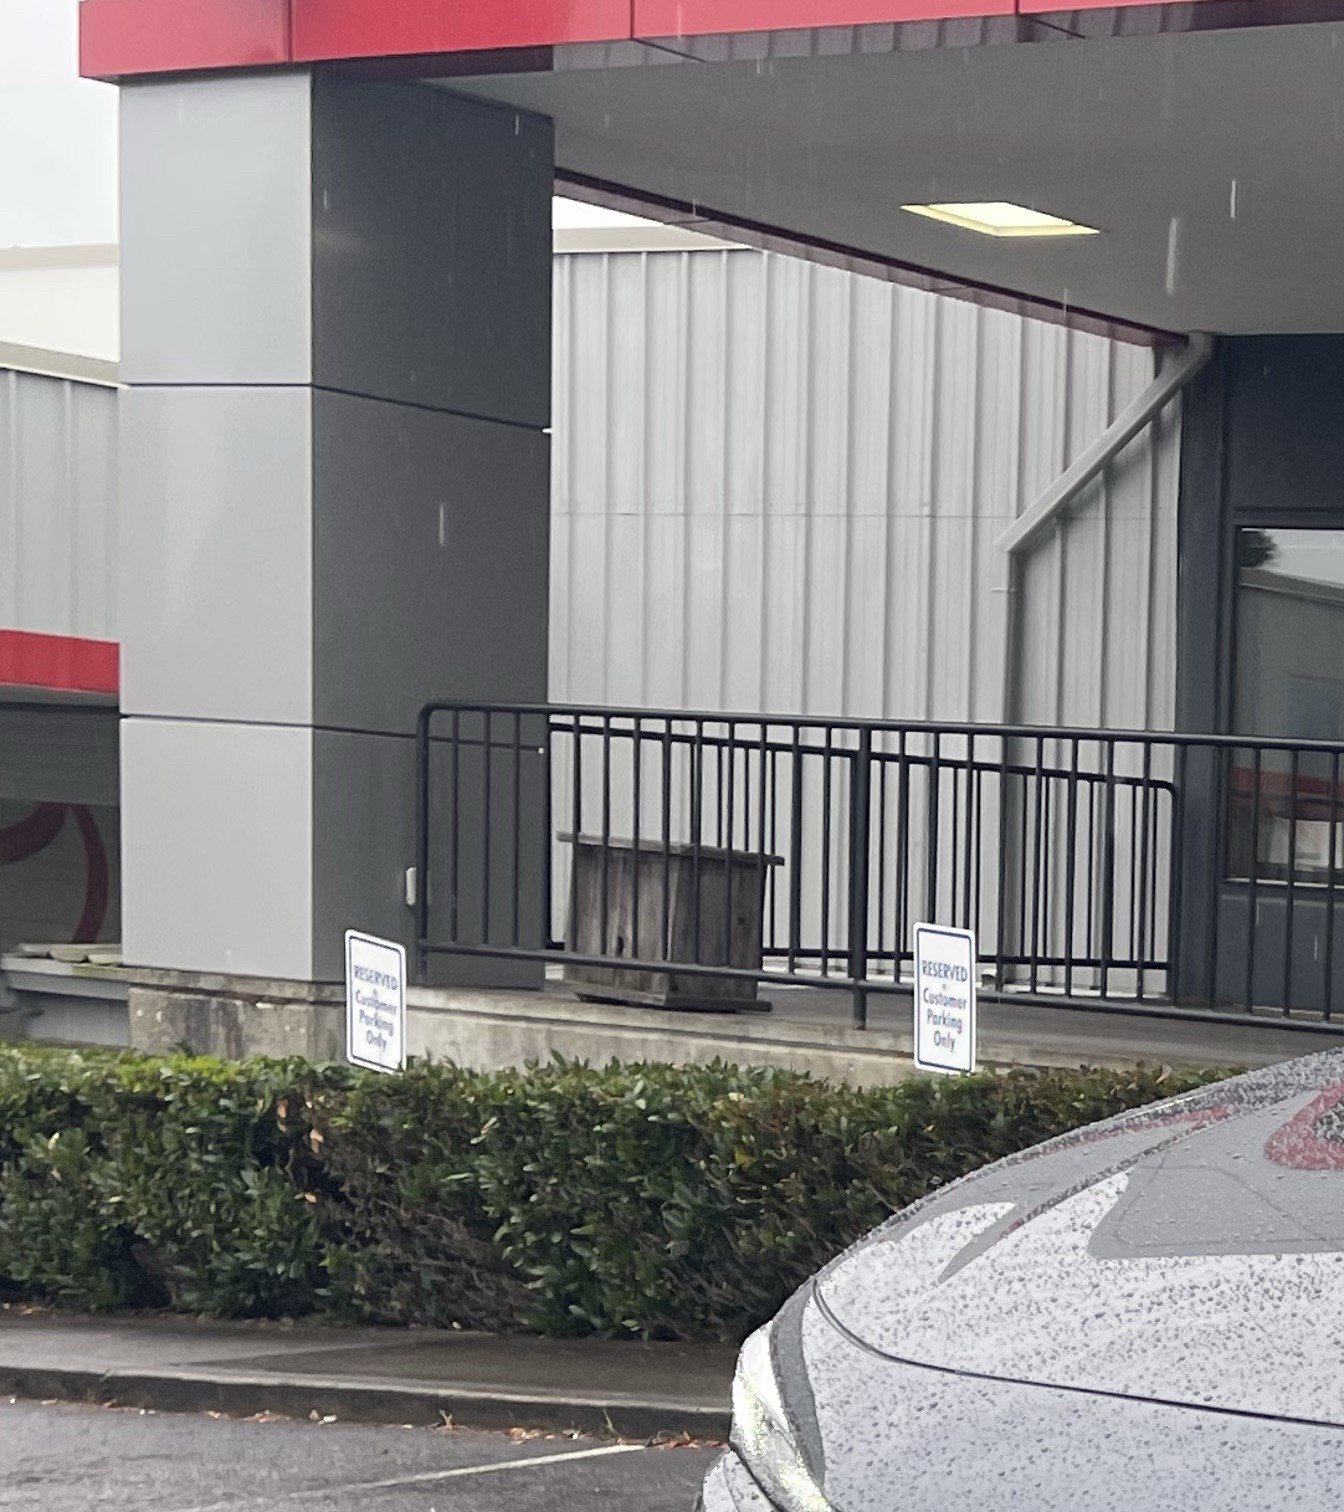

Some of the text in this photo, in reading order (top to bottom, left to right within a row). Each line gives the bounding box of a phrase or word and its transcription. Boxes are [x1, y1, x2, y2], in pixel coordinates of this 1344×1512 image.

[354, 965, 398, 990] RESERVED
[922, 960, 968, 982] RESERVED
[923, 988, 967, 1009] Customer
[927, 1008, 963, 1034] Parking
[934, 1030, 956, 1052] Only
